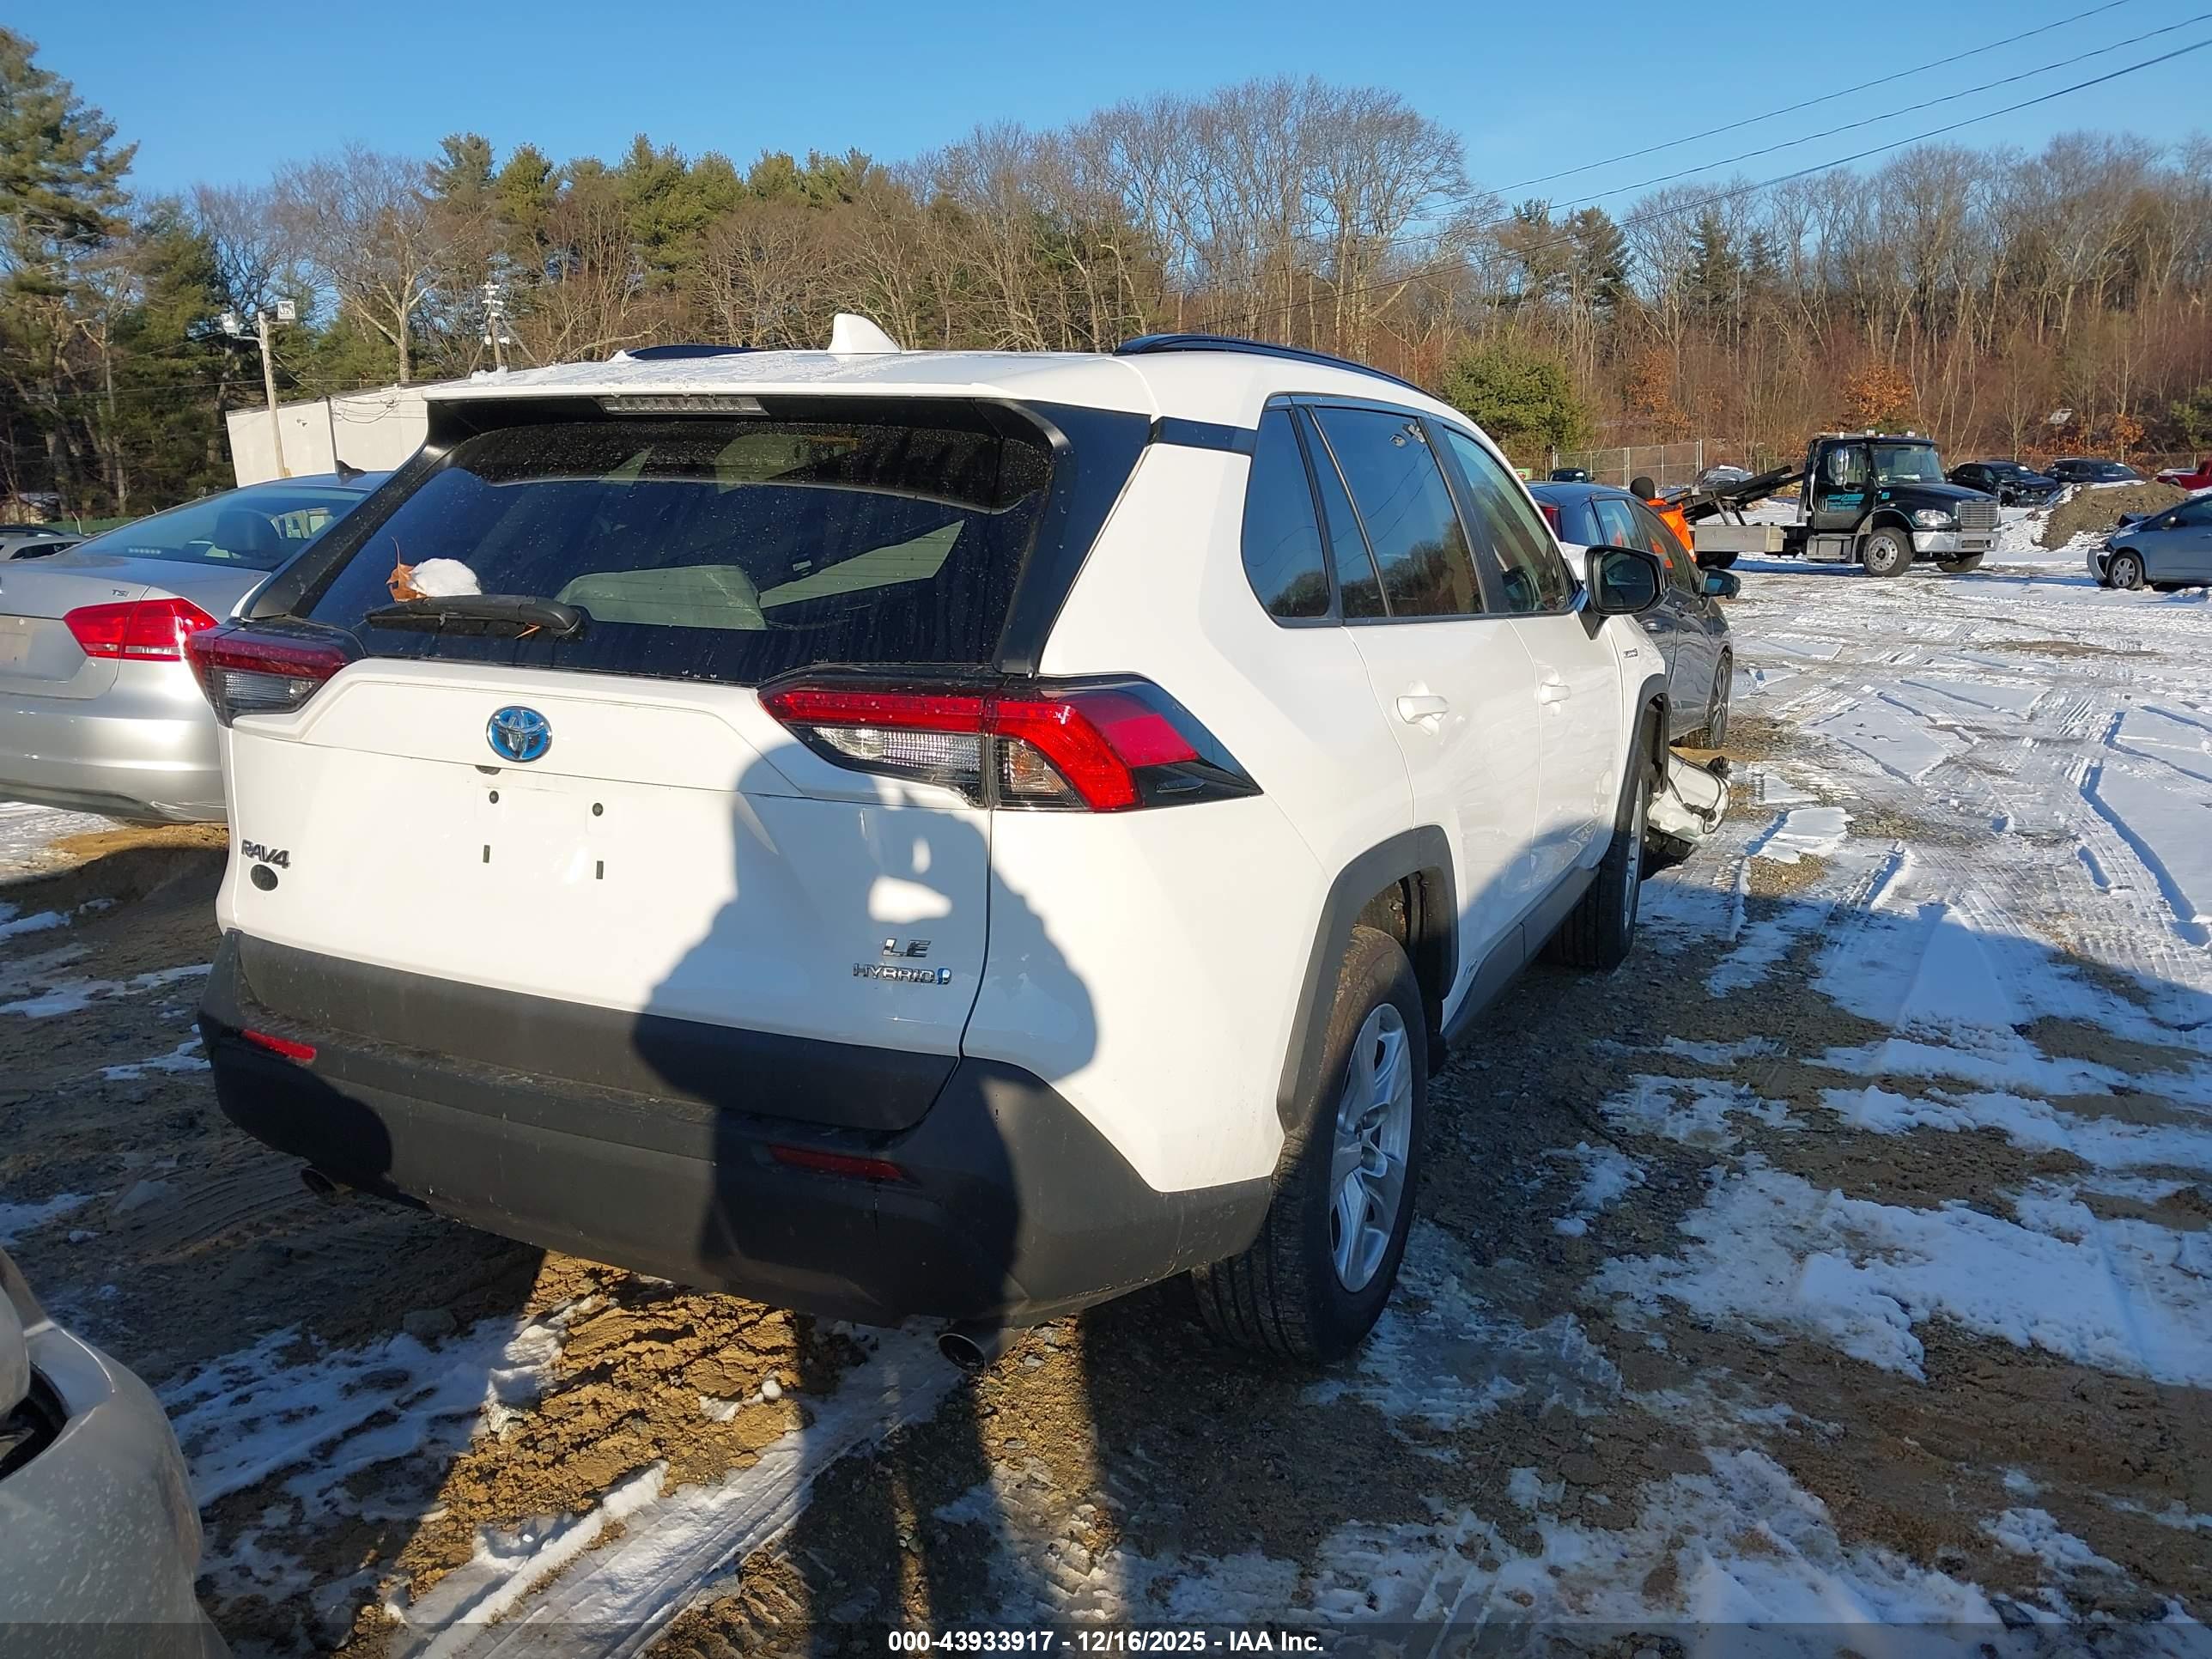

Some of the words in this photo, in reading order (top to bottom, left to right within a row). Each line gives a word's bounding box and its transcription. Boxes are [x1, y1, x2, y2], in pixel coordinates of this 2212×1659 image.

[241, 839, 291, 869] RAV4
[882, 938, 932, 958] LE
[853, 963, 936, 984] HYBRID
